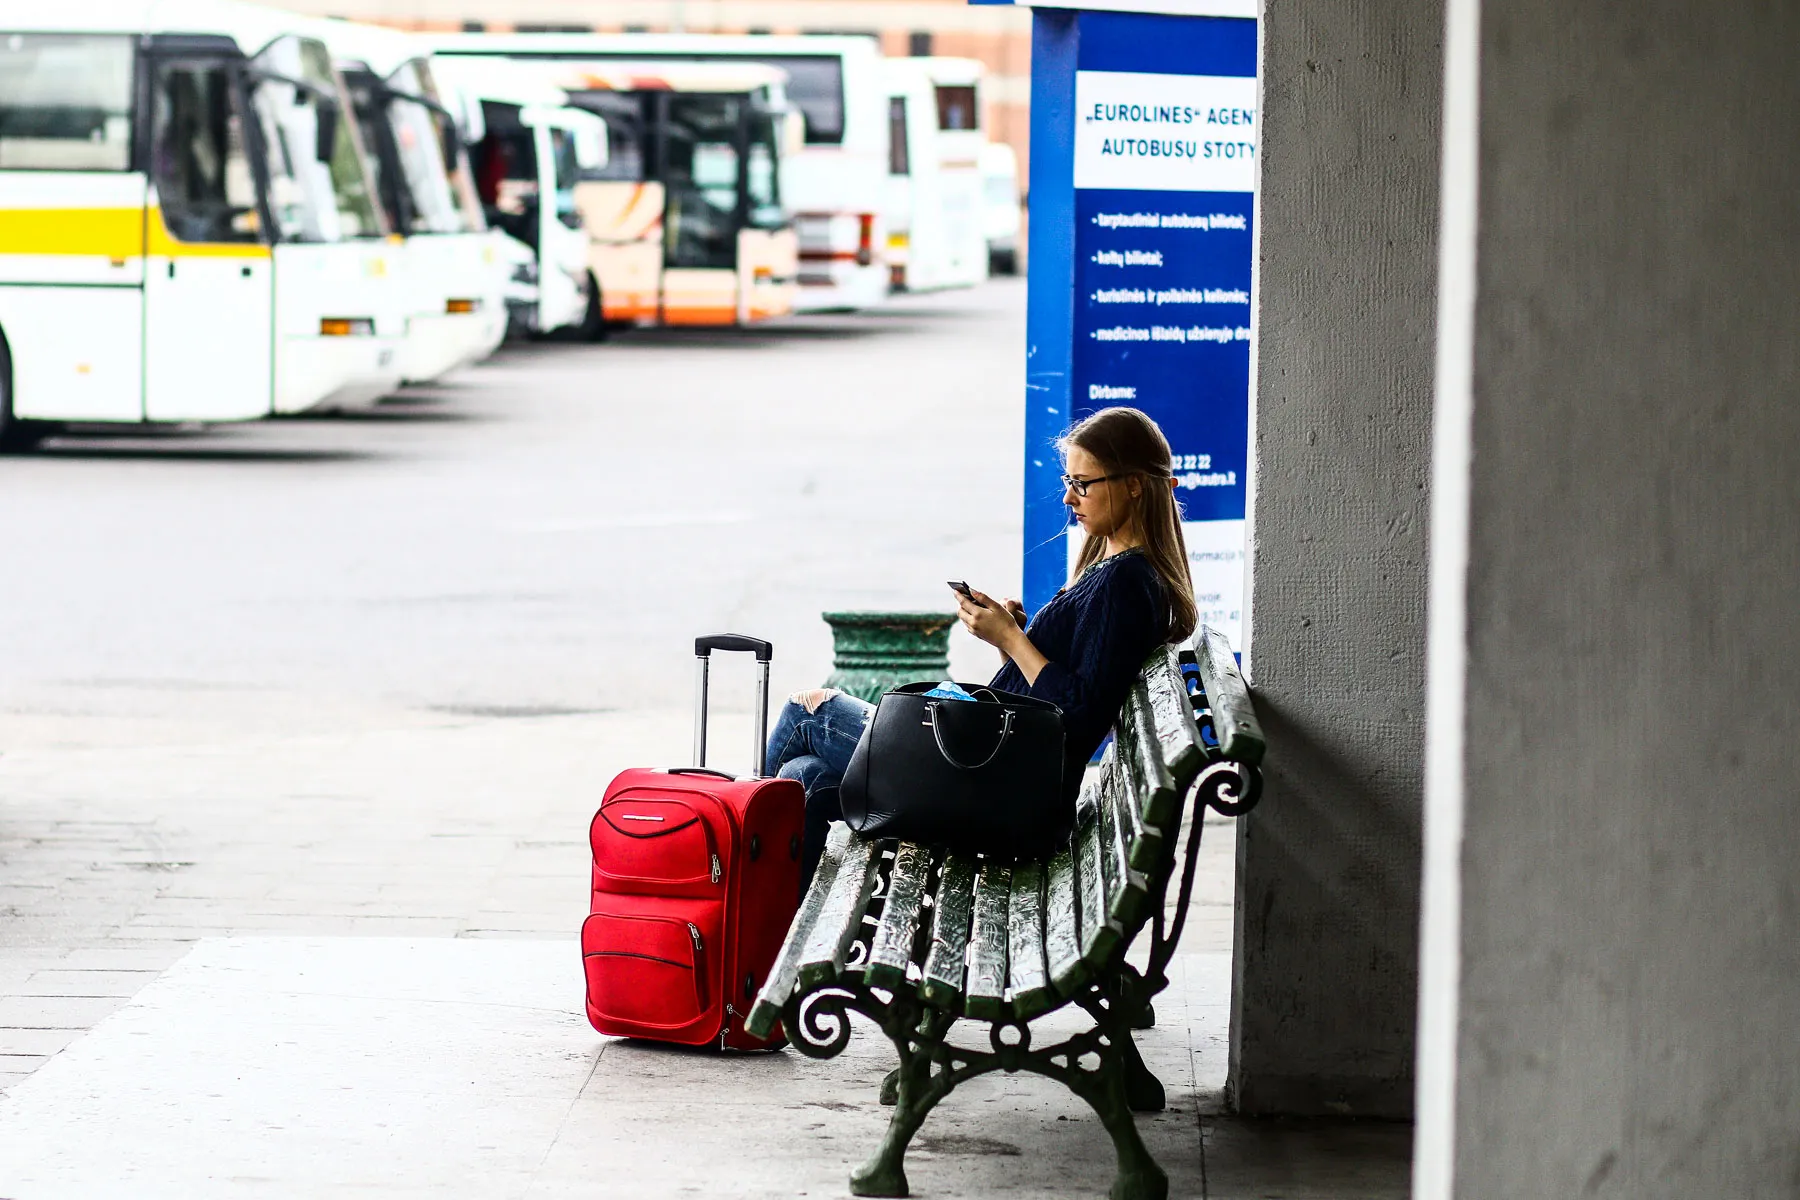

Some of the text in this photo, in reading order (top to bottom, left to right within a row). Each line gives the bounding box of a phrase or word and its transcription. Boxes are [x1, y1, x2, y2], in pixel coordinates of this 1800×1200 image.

[1101, 137, 1256, 161] AUTOBUSŲ STOTY
[1096, 326, 1151, 341] medicinos
[1089, 384, 1137, 400] Dirbame:
[1184, 454, 1197, 470] 22
[1198, 454, 1211, 470] 22
